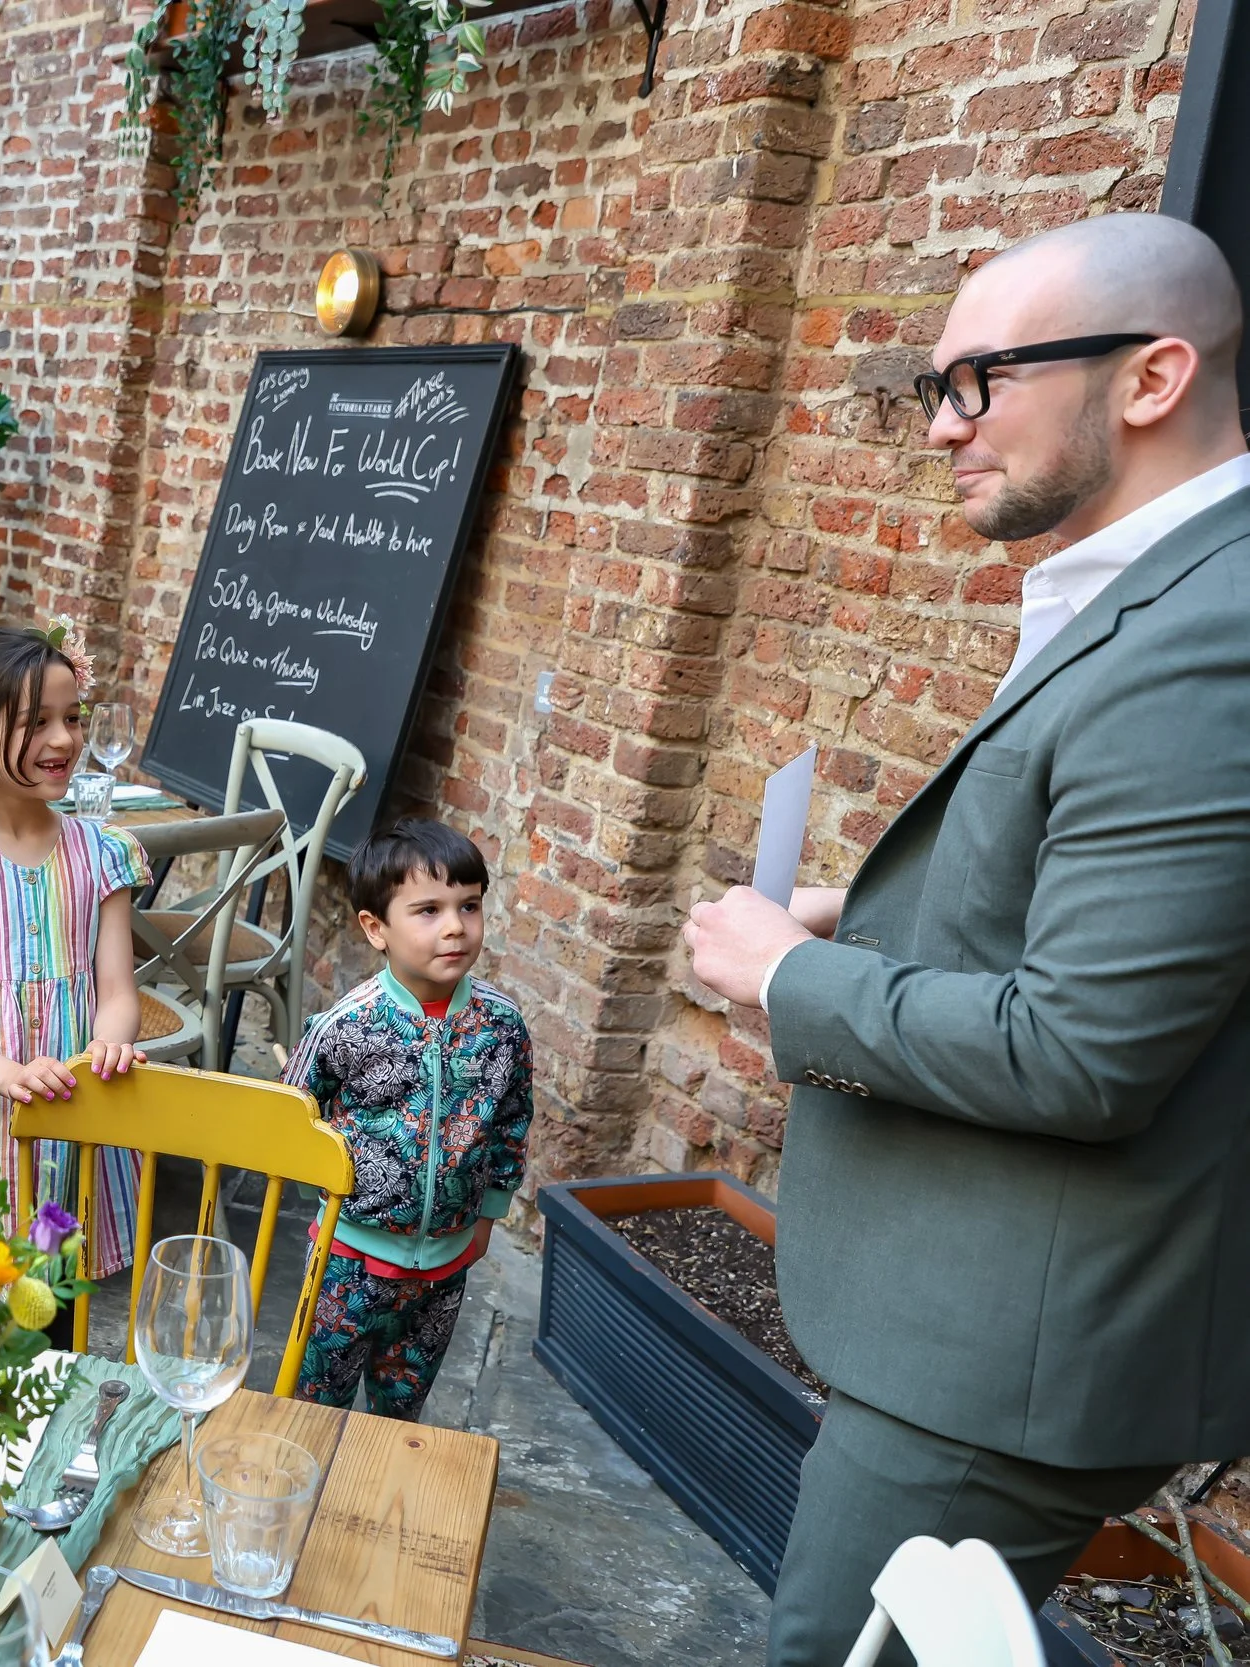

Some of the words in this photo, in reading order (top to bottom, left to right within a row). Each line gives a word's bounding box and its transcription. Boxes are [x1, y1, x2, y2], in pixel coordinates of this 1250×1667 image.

[328, 402, 363, 413] VICTORIA
[363, 403, 392, 414] STAKES
[243, 415, 284, 475] Book
[285, 415, 319, 476] Now
[323, 428, 349, 477] For
[358, 429, 411, 478] World
[412, 434, 463, 491] Cup!
[387, 525, 403, 552] to
[405, 525, 434, 557] hire
[209, 568, 249, 609] 50%
[316, 597, 379, 651] Wednesday
[270, 645, 320, 695] Thursday
